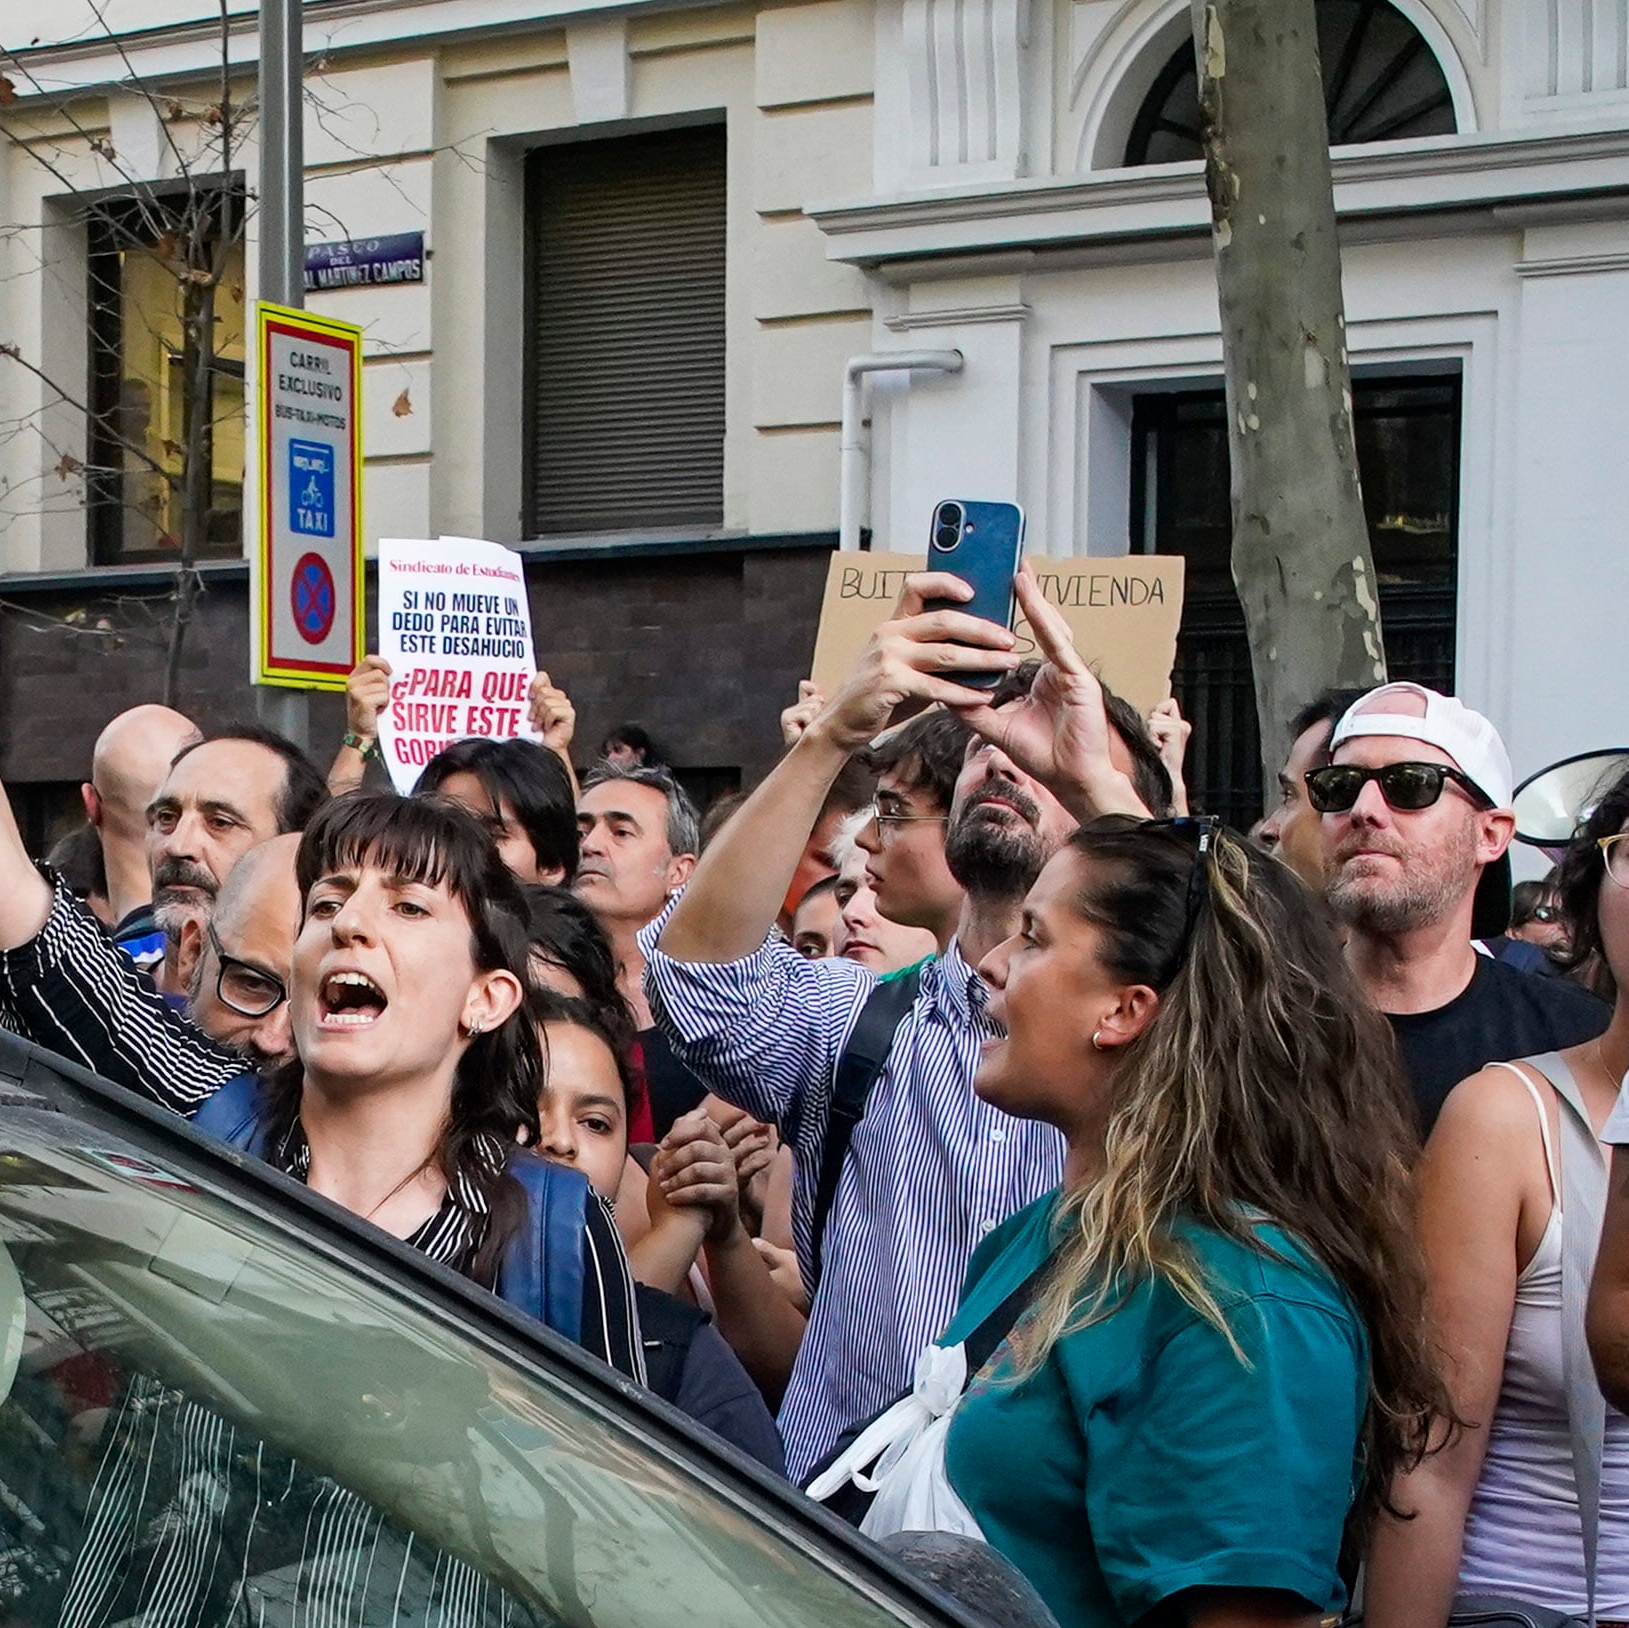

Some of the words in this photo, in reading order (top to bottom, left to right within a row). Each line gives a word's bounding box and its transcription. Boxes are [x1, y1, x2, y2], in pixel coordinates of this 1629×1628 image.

[372, 259, 421, 282] CAMPOS
[290, 352, 332, 374] CARRIL
[278, 374, 342, 401] EXCLUSIVO
[297, 508, 328, 532] TAXI
[389, 560, 453, 575] Sindicato
[455, 562, 471, 576] de
[403, 590, 419, 610] SI
[425, 591, 447, 611] NO
[452, 593, 501, 614] MUEVE
[504, 597, 520, 617] UN
[392, 612, 435, 632] DEDO
[440, 615, 480, 634] PARA
[486, 617, 528, 638] EVITAR
[400, 634, 437, 653] ESTE
[442, 636, 525, 659] DESAHUCIO
[391, 668, 473, 700] ¿PARA
[481, 667, 528, 703] QUÉ
[392, 702, 459, 733] SIRVE
[466, 705, 521, 737] ESTE
